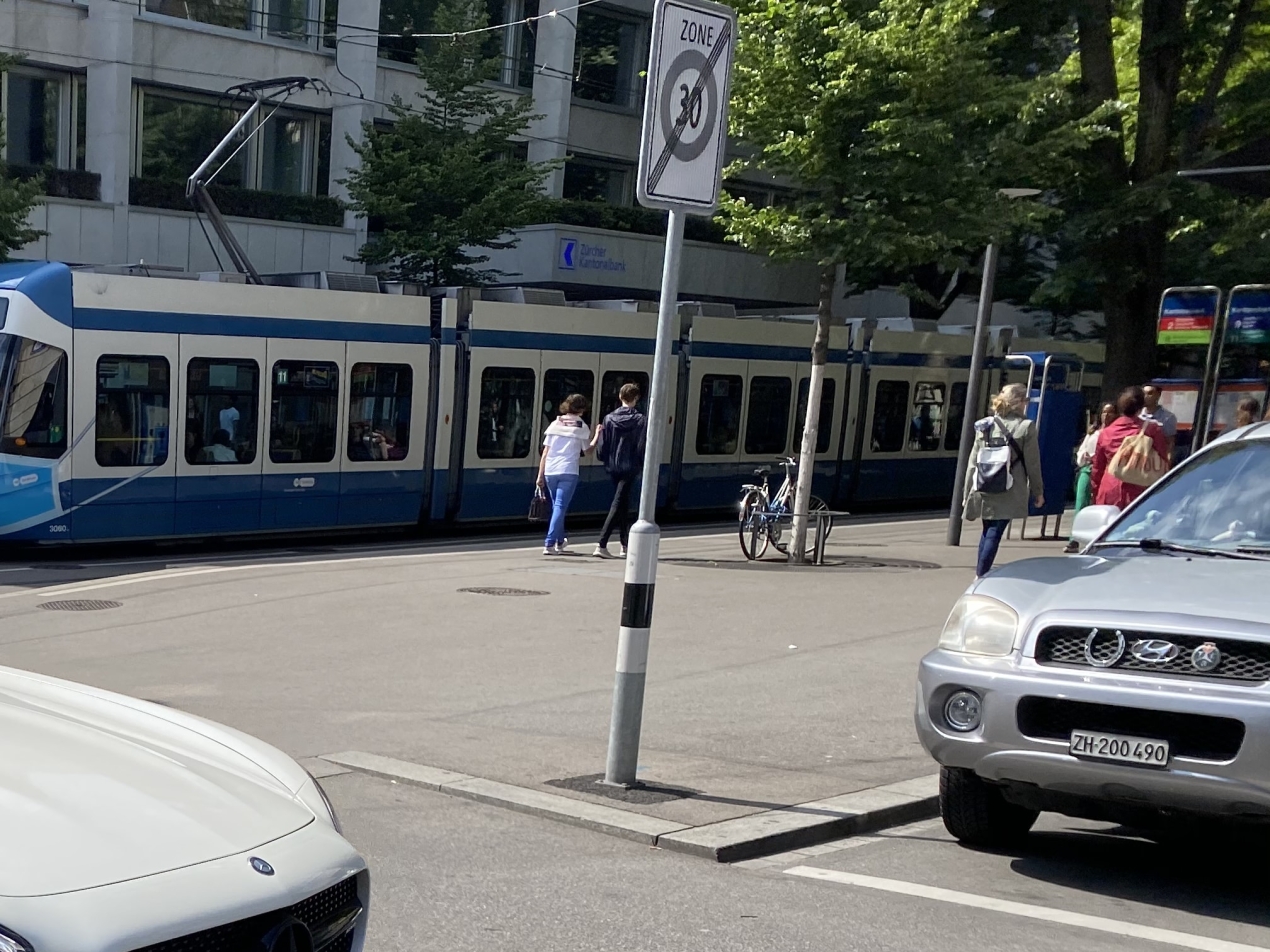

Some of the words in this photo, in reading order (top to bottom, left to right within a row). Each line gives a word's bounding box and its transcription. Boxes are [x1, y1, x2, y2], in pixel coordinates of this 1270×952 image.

[680, 19, 714, 47] ZONE
[676, 83, 702, 129] 30
[278, 370, 287, 383] 11
